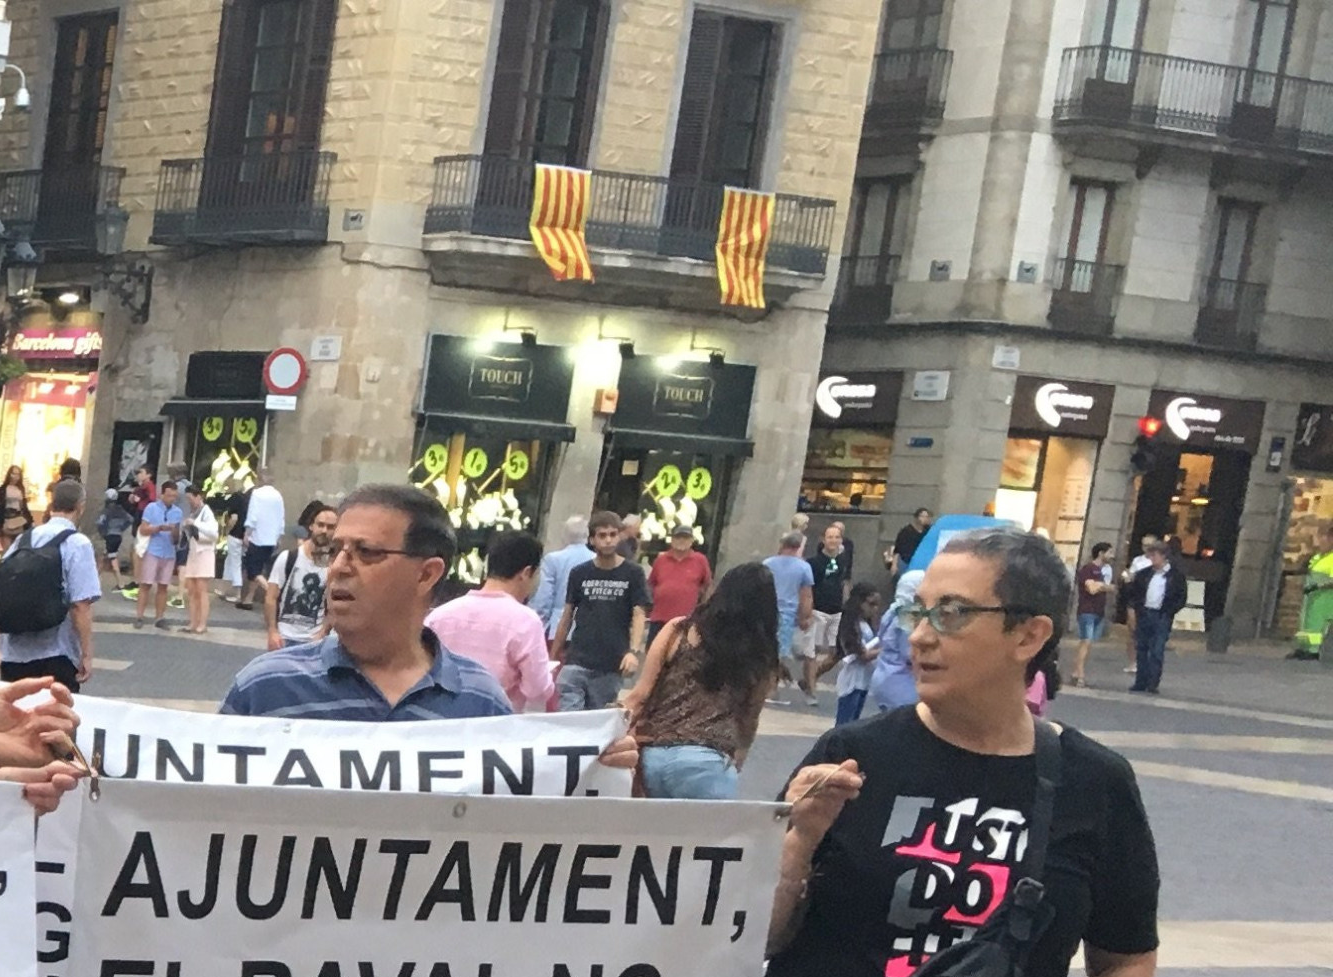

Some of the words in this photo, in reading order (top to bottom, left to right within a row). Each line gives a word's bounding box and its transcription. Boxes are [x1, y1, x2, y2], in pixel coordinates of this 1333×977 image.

[480, 367, 523, 386] TOUCH
[663, 385, 704, 402] TOUCH
[101, 832, 748, 942] AJUNTAMENT,
[900, 861, 1005, 922] DO
